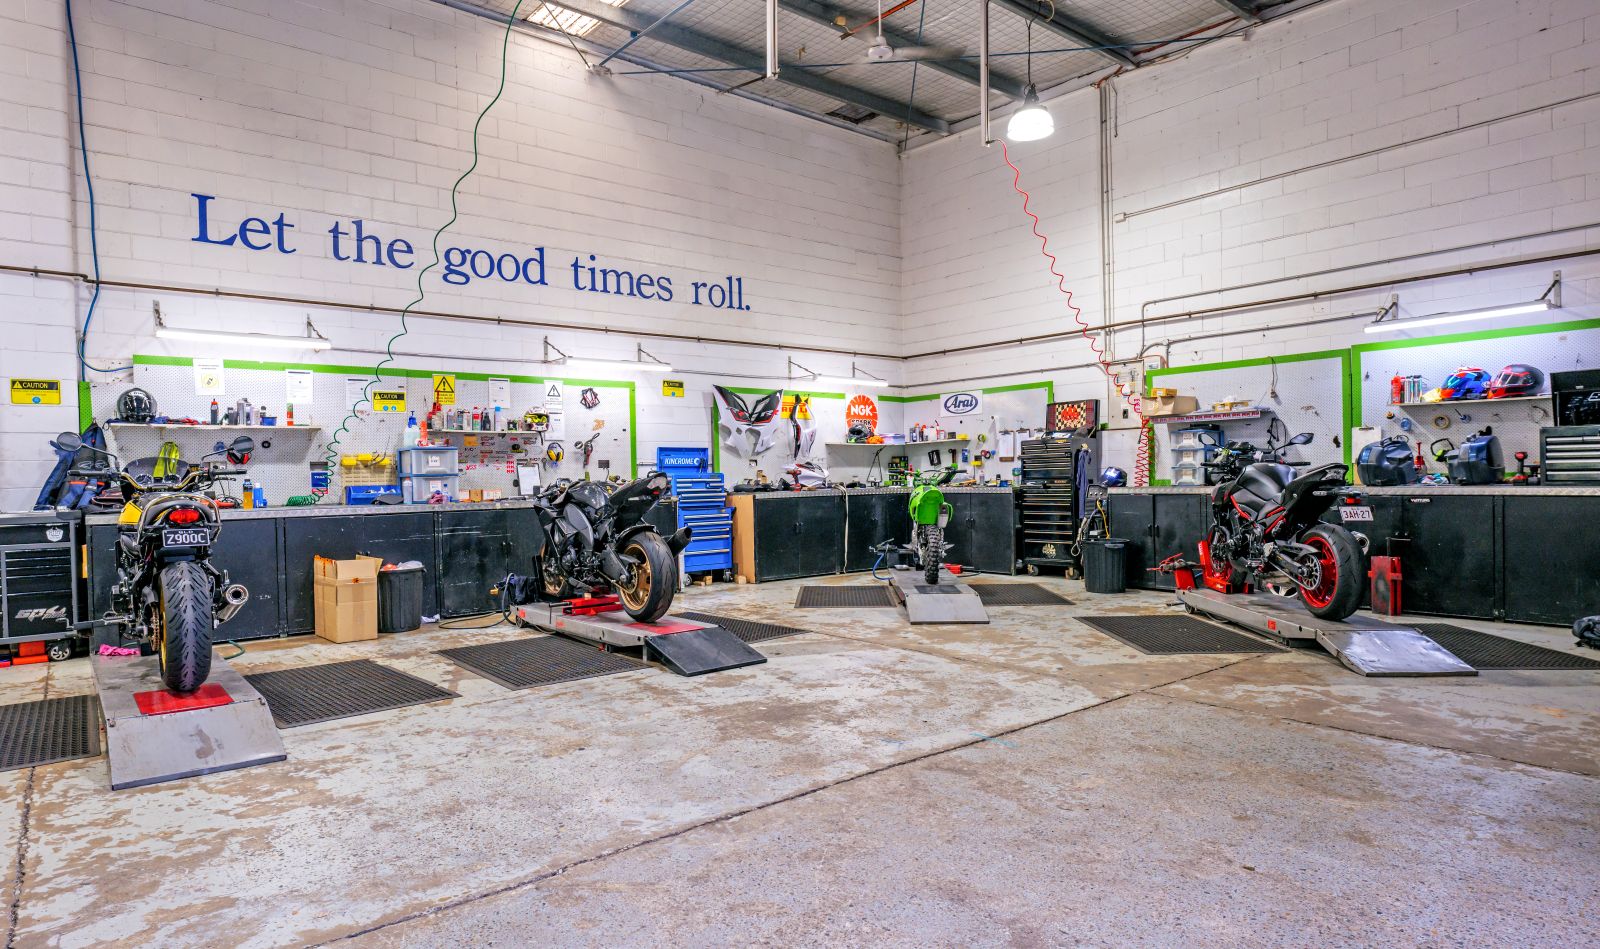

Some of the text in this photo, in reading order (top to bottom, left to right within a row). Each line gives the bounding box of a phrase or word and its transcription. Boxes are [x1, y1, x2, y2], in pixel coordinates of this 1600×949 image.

[191, 193, 752, 312] Let the good times roll.
[946, 394, 974, 409] Arai
[850, 405, 872, 416] NGK
[166, 533, 206, 544] Z900C
